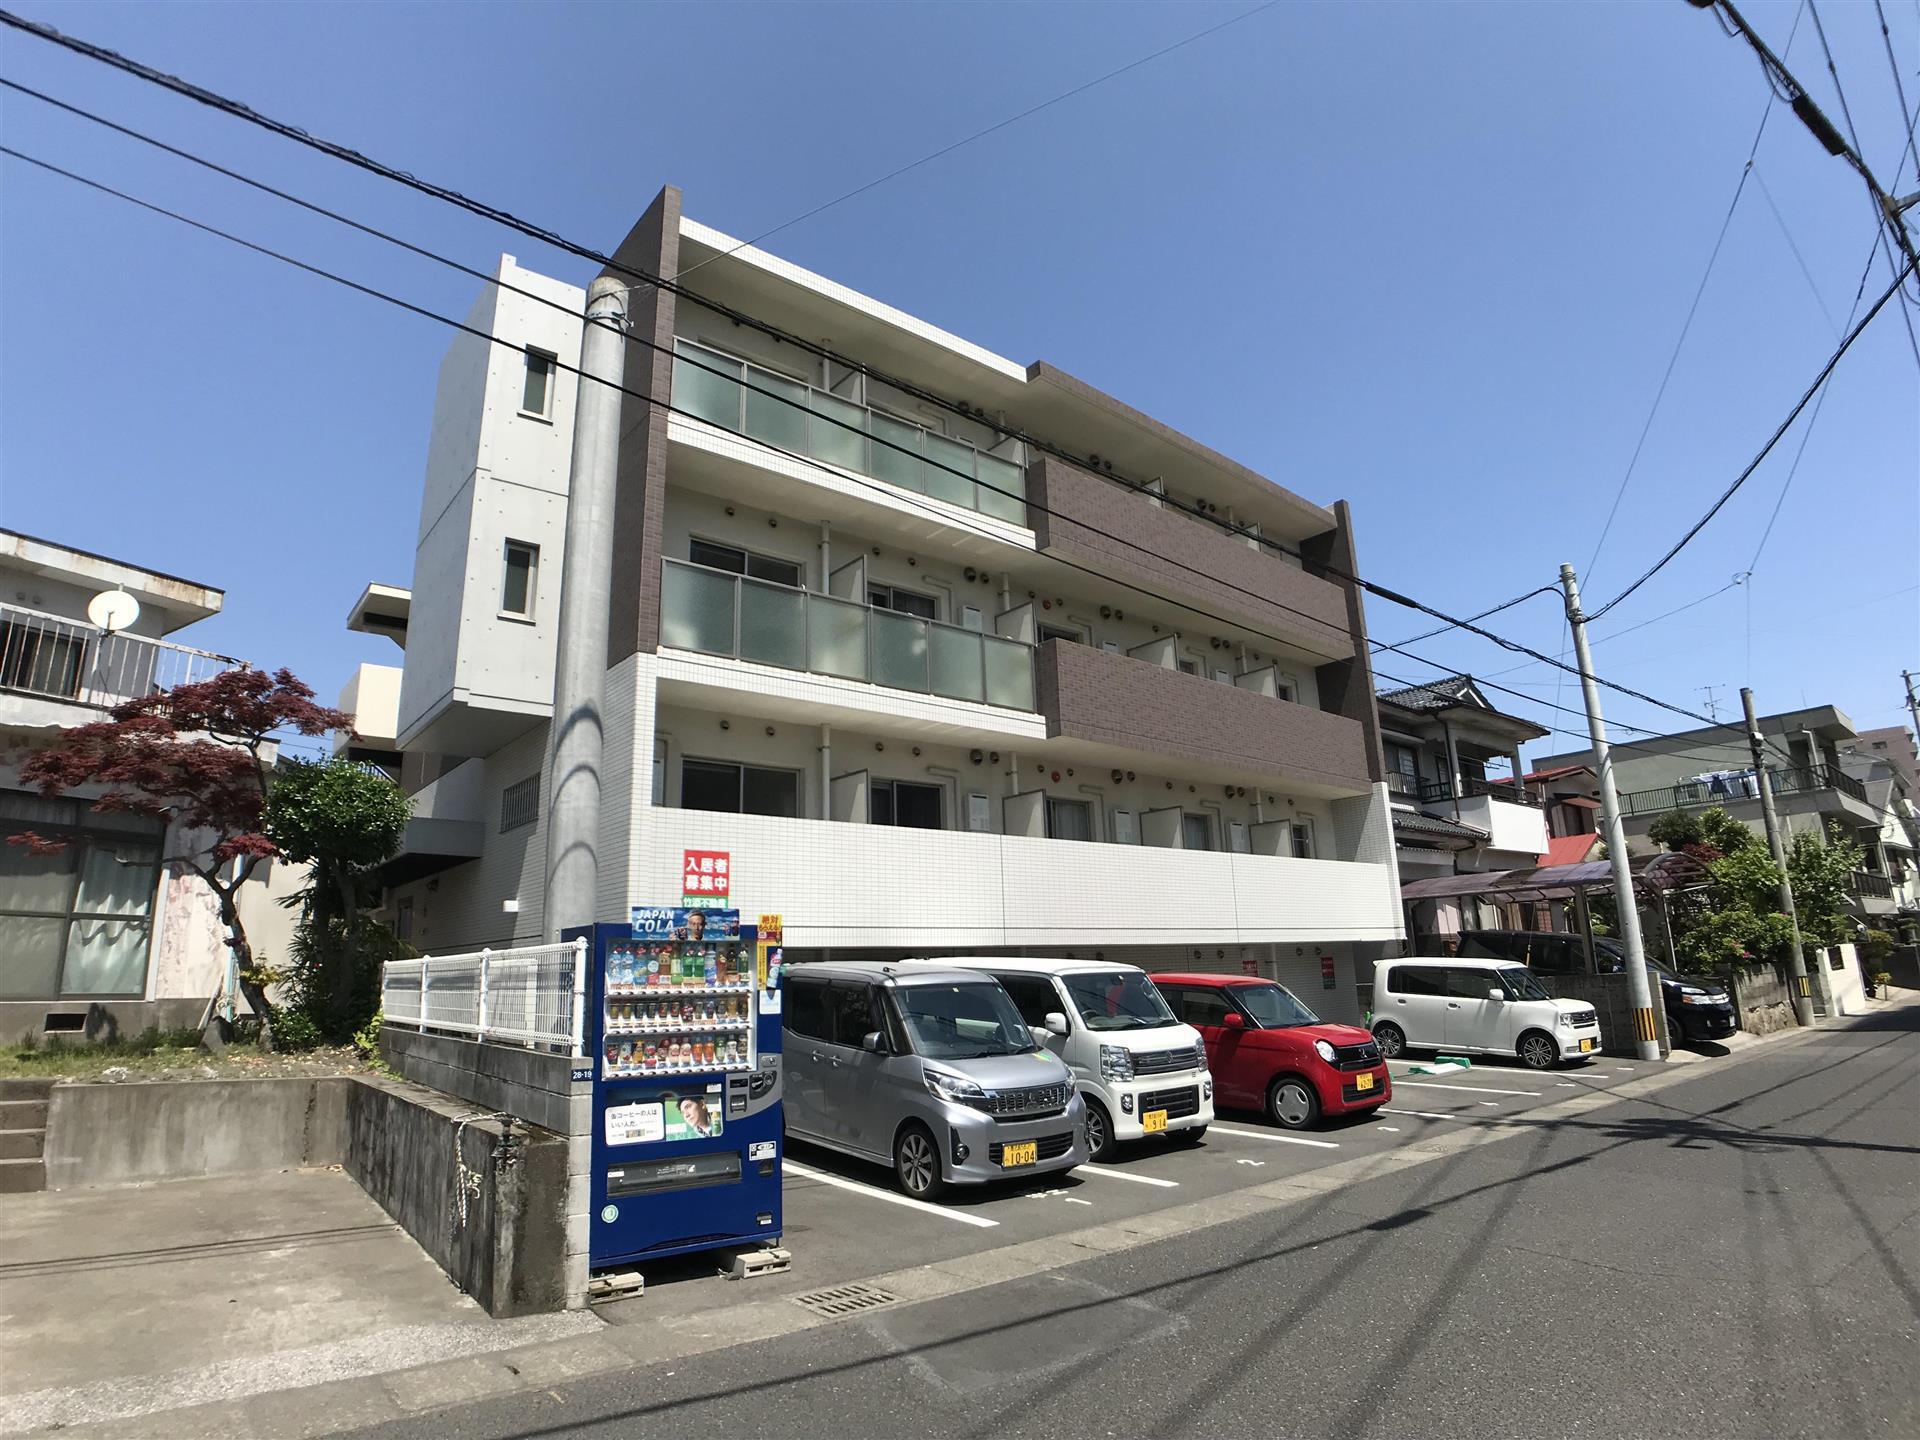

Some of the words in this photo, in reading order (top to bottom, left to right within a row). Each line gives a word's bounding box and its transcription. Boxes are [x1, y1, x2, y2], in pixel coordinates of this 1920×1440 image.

[686, 857, 728, 873] 入居者
[685, 874, 728, 891] 募集中
[637, 910, 675, 920] JAPAN
[635, 919, 675, 933] COLA
[572, 1070, 593, 1080] 28-19
[1011, 1150, 1035, 1165] 10-04
